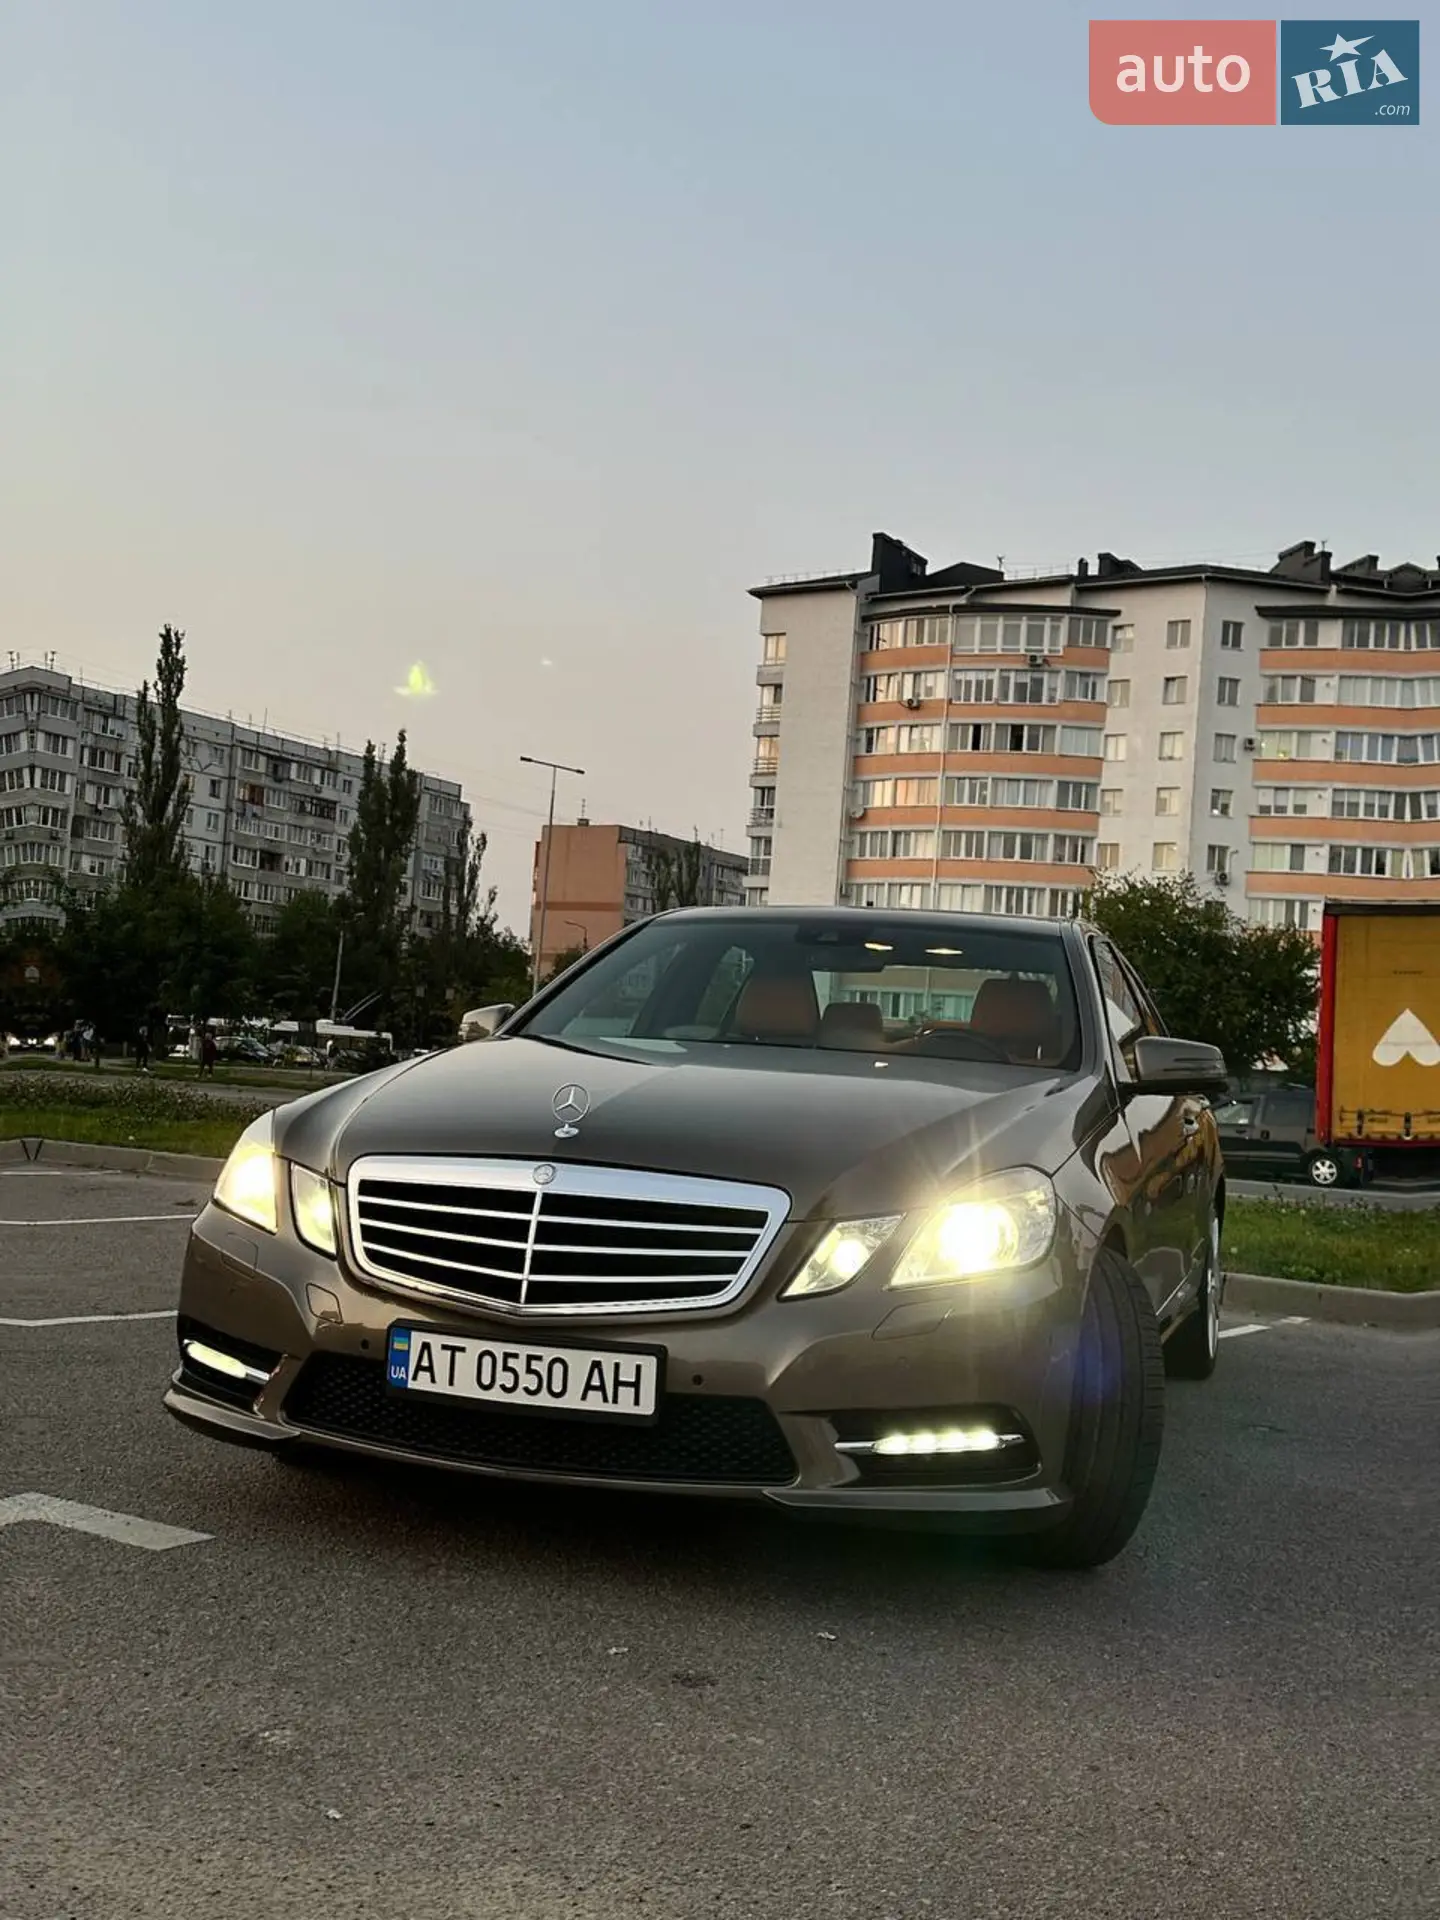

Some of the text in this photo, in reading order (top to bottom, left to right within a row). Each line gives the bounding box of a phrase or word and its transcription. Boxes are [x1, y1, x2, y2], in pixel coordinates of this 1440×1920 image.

[391, 1366, 408, 1380] UA
[411, 1341, 642, 1407] AT 0550 AH
